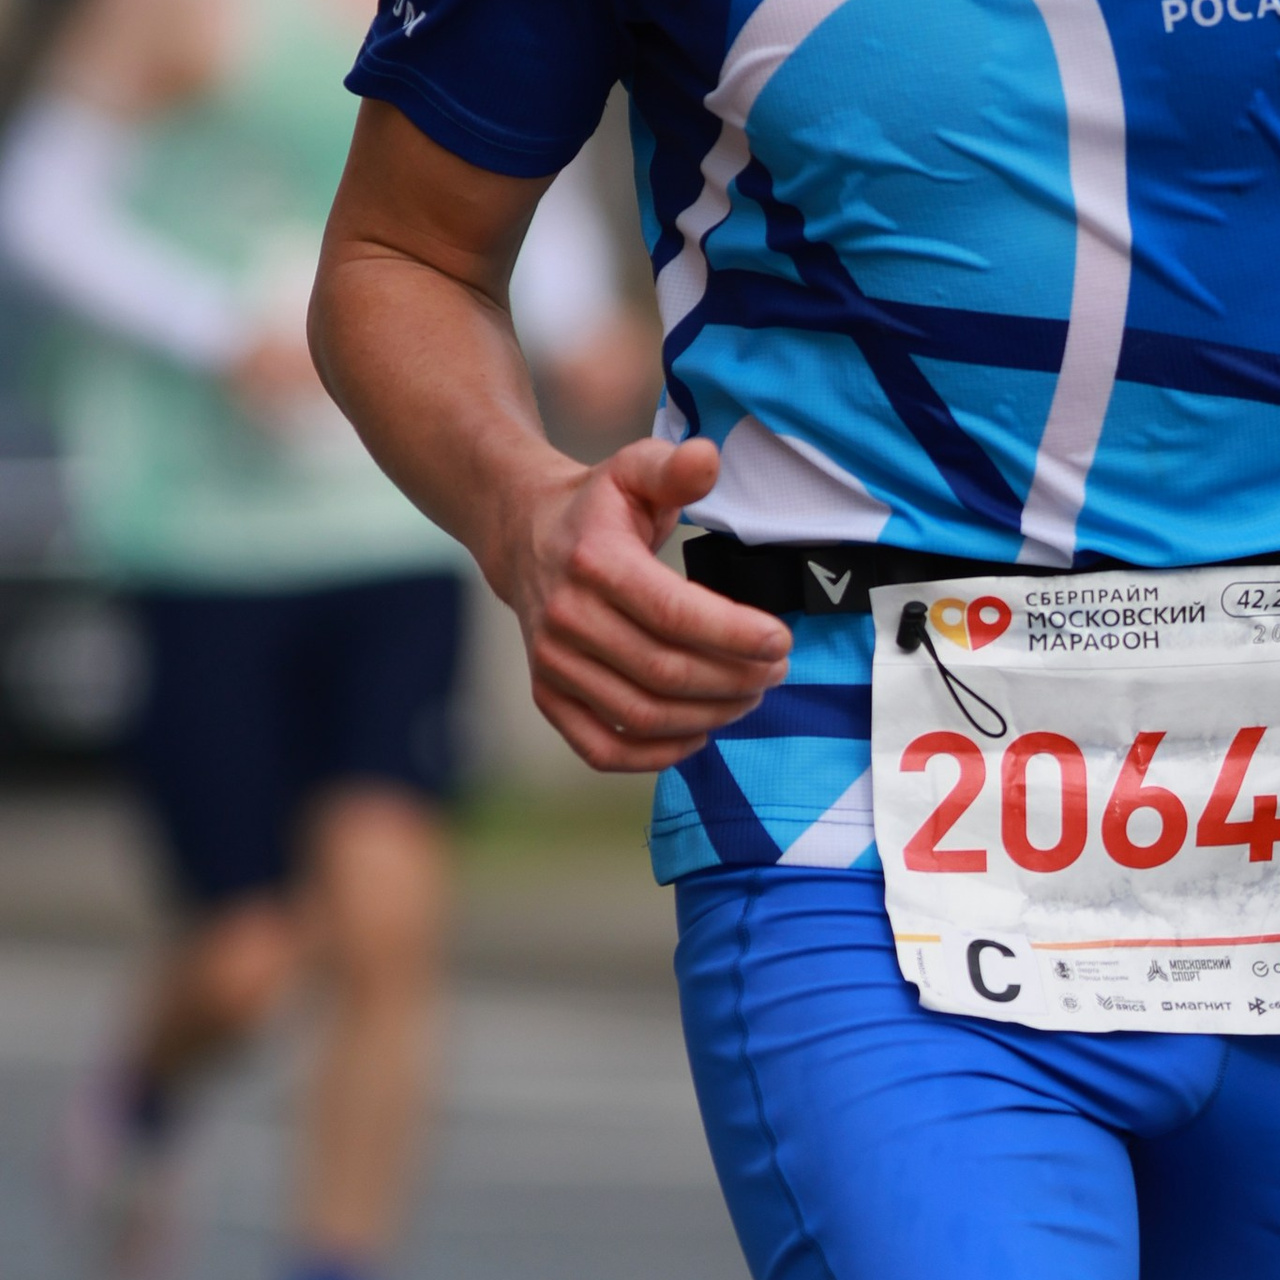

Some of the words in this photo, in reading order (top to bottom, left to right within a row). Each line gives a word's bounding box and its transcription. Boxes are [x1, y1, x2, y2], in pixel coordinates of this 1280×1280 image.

[1025, 584, 1159, 607] СБЕРПРАЙМ
[1027, 601, 1206, 630] МОСКОВСКИЙ
[1028, 630, 1160, 652] МАРАФОН
[1169, 956, 1232, 970] МОСКОВСКИЙ
[1171, 970, 1201, 982] СПОРТ
